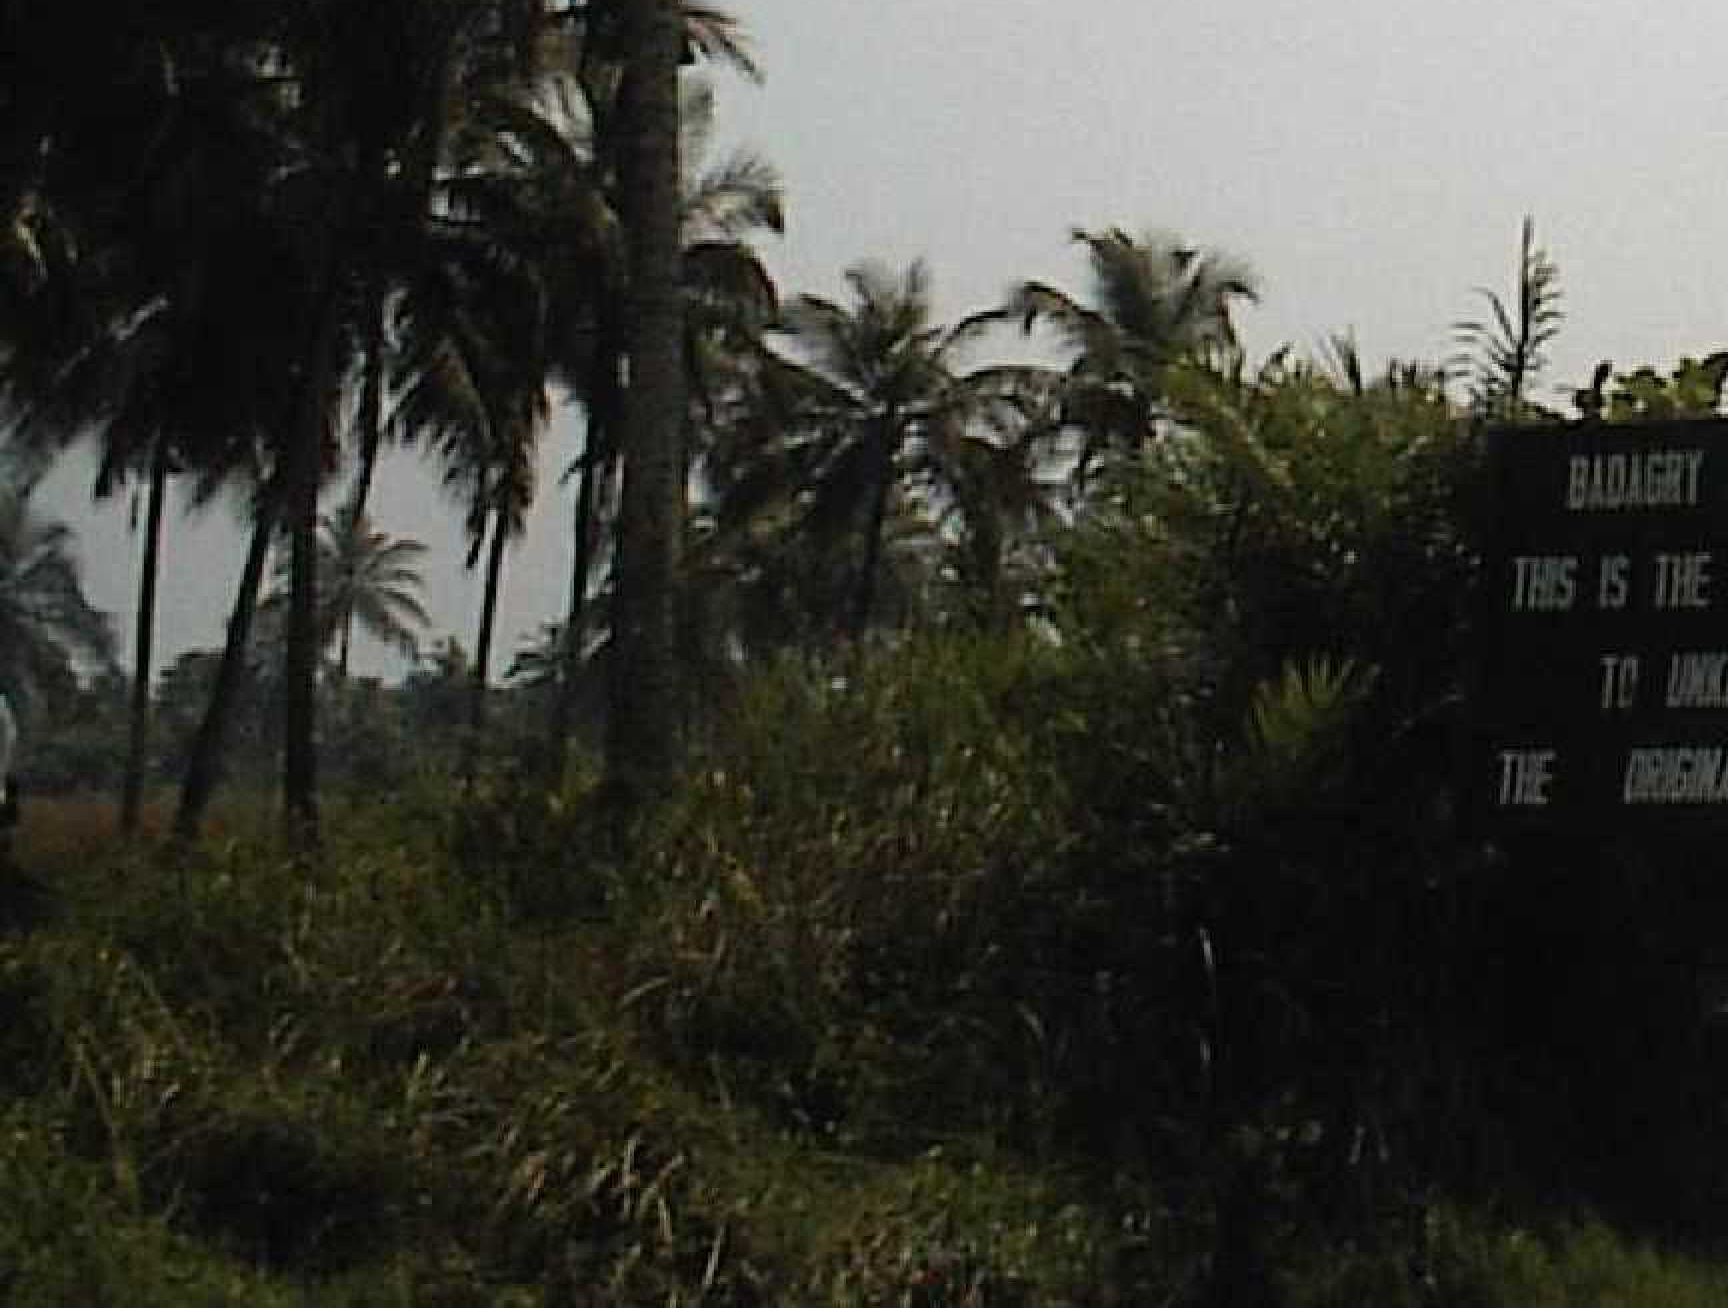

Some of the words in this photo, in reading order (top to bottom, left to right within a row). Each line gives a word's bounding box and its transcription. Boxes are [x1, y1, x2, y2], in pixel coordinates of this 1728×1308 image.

[1510, 554, 1578, 610] THIS
[1600, 553, 1632, 608] IS
[1656, 553, 1712, 607] THE
[1600, 655, 1639, 709] TO
[1498, 749, 1557, 805] THE
